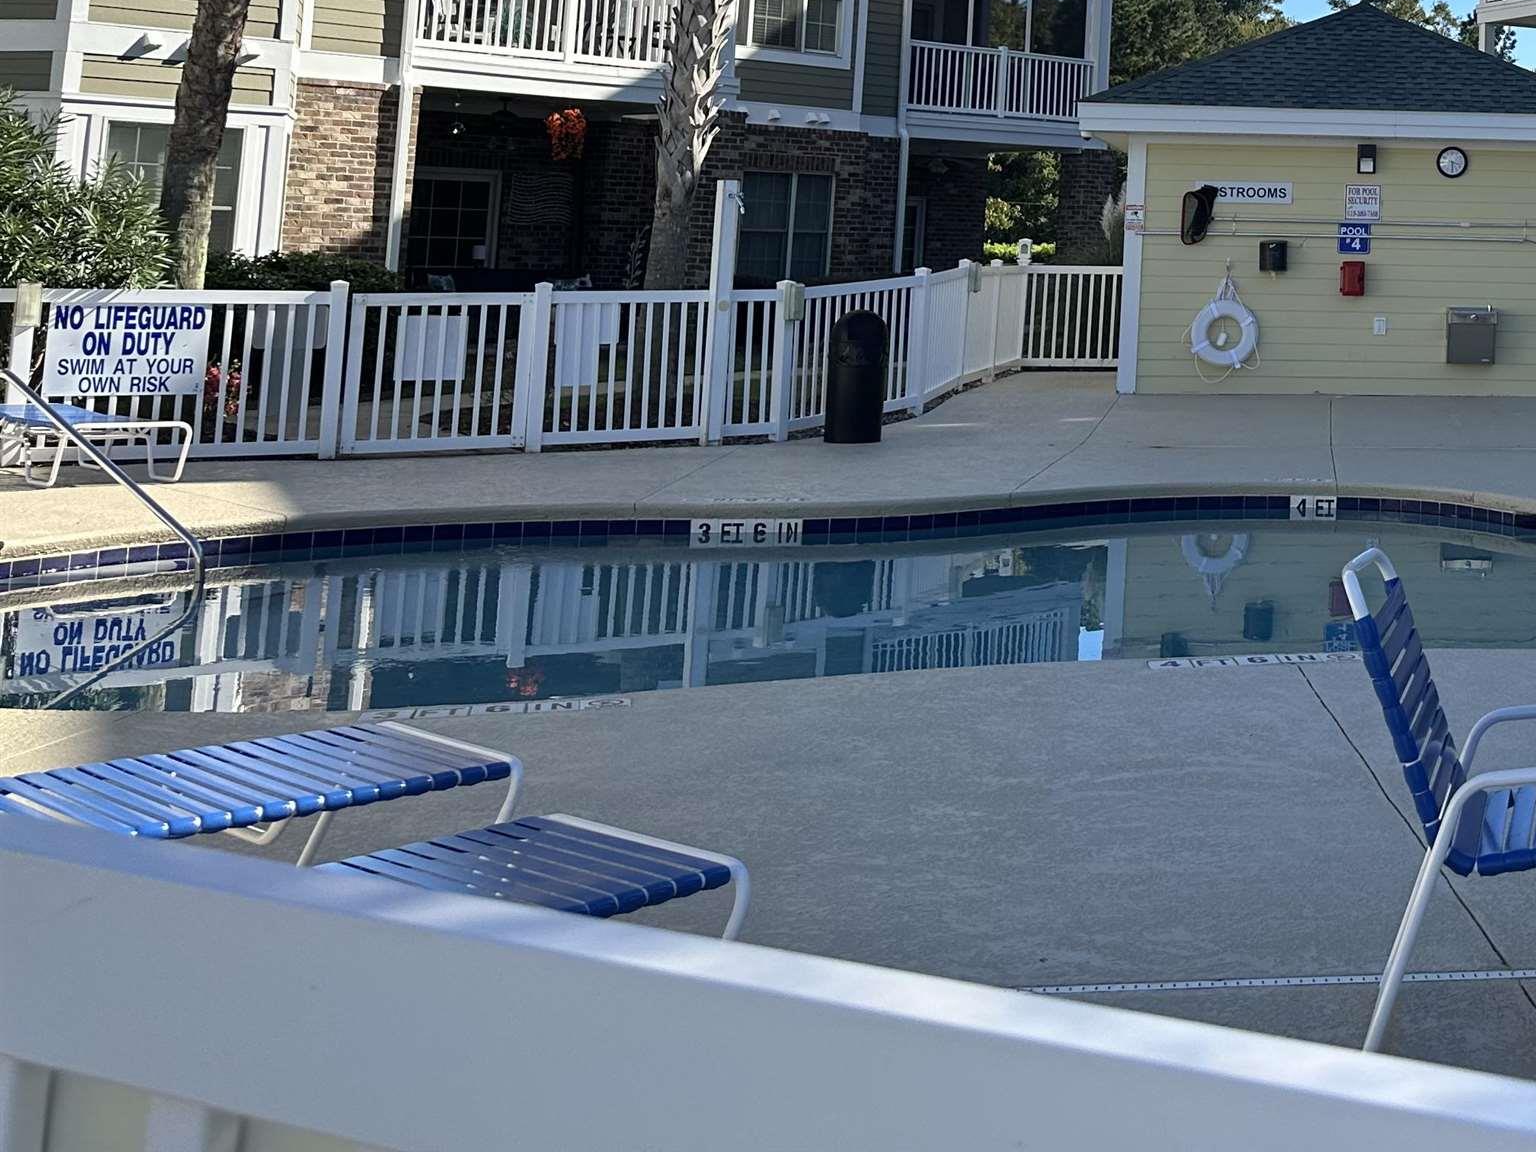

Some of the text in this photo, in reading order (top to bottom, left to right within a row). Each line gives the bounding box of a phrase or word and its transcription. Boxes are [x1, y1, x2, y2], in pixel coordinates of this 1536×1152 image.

[1216, 186, 1287, 199] STROOMS
[1340, 227, 1367, 236] POOL
[54, 305, 206, 330] NO LIFEGUARD
[82, 332, 176, 356] ON DUTY
[57, 358, 194, 375] SWIM AT YOUR
[78, 376, 171, 393] OWN RISK
